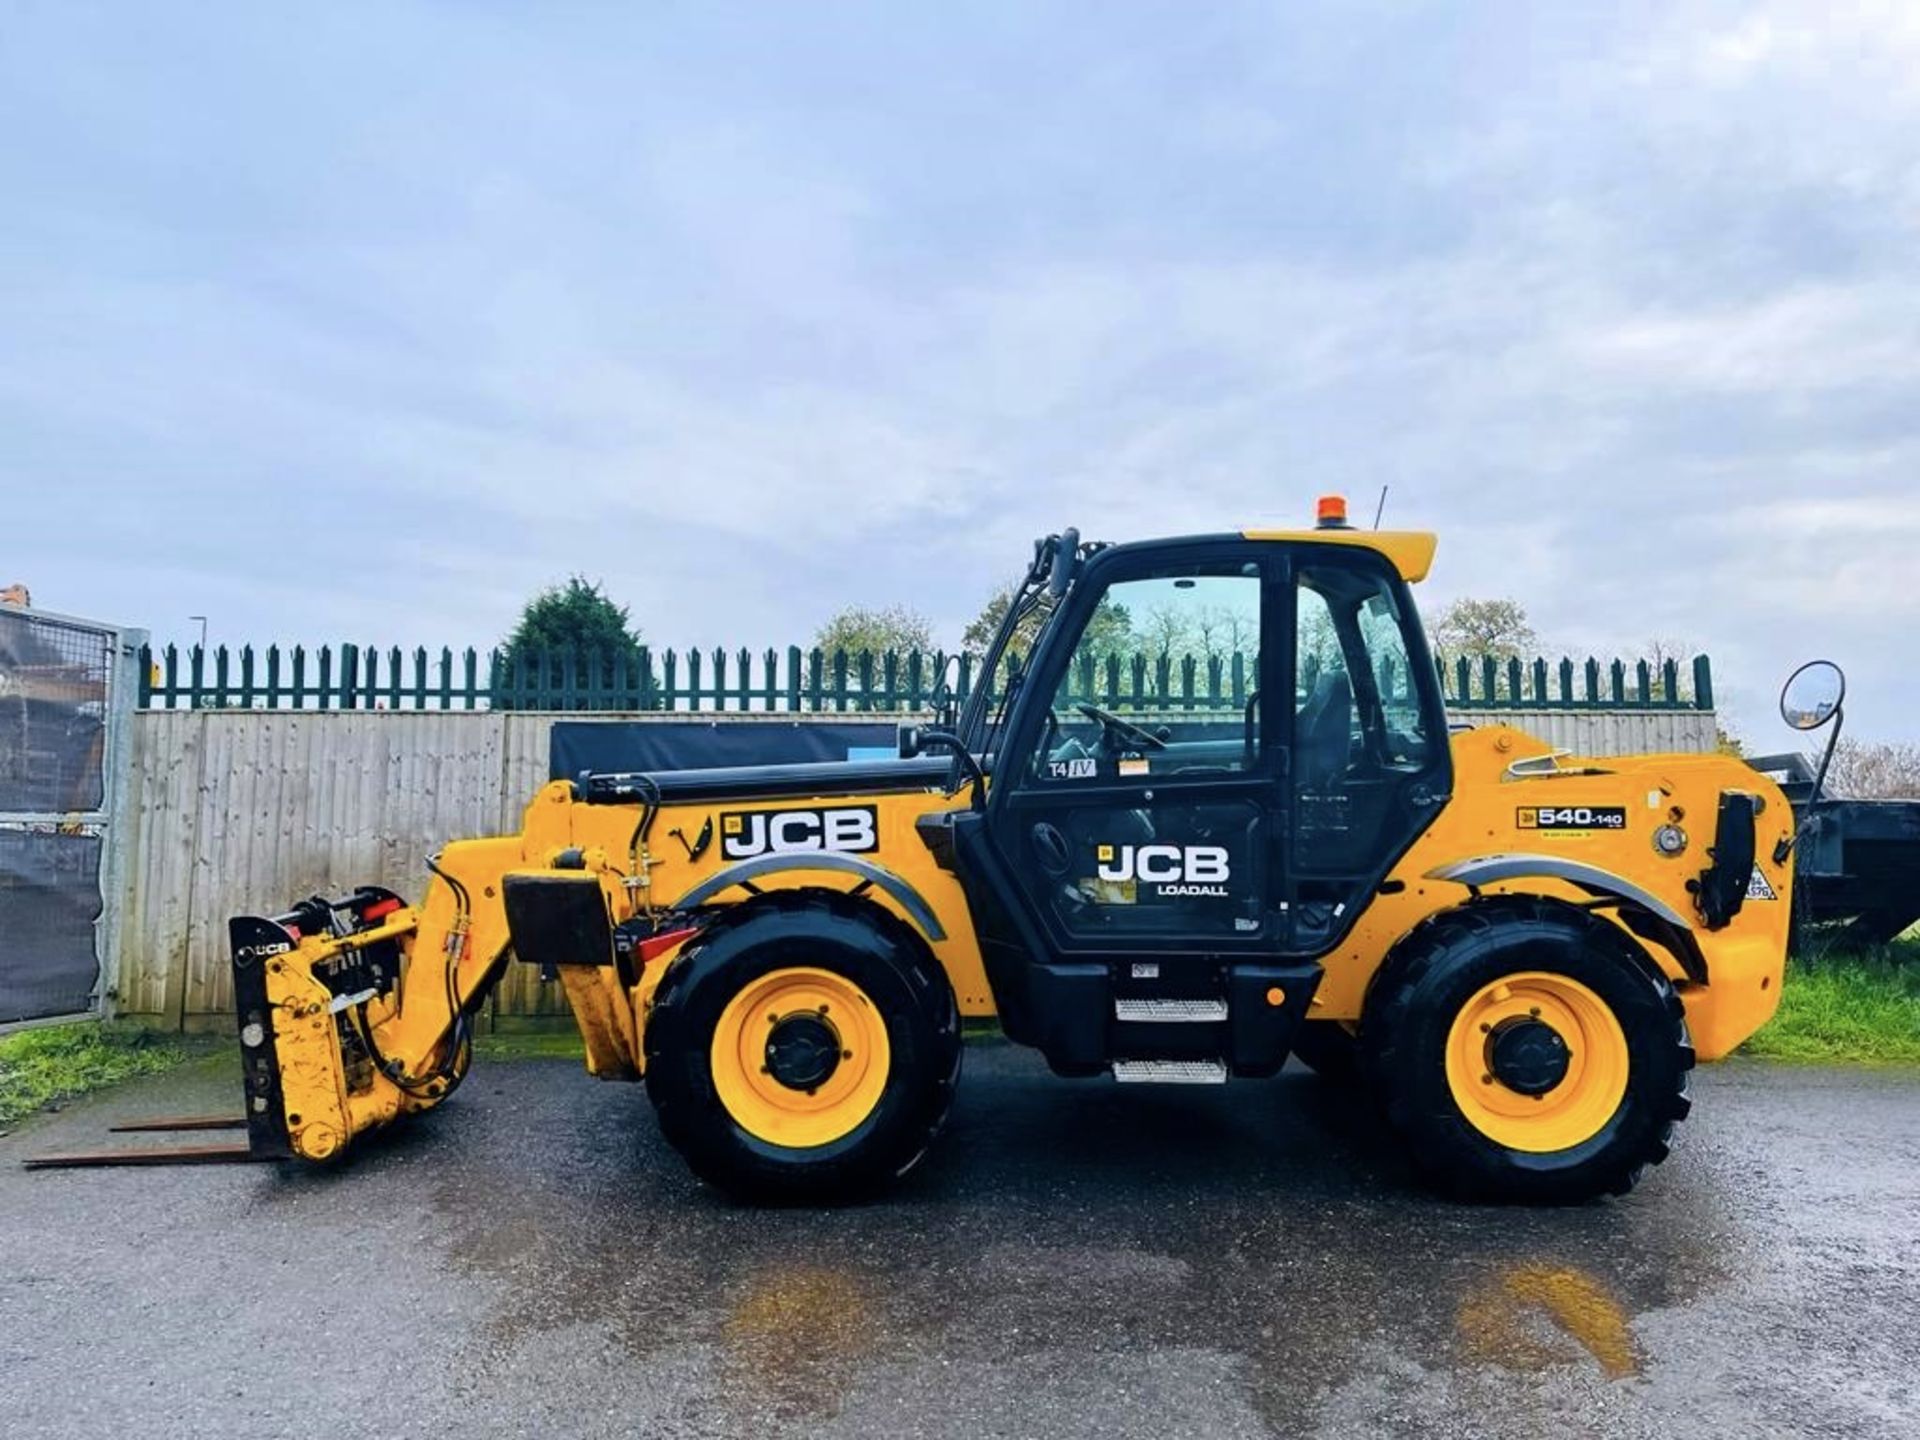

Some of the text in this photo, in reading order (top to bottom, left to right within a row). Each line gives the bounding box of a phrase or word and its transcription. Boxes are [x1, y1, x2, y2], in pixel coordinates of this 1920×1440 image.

[1048, 760, 1092, 777] T4 IV
[1539, 808, 1623, 825] 540-140
[725, 808, 876, 857] JCB
[1098, 845, 1231, 883] JCB
[1157, 884, 1229, 896] LOADALL
